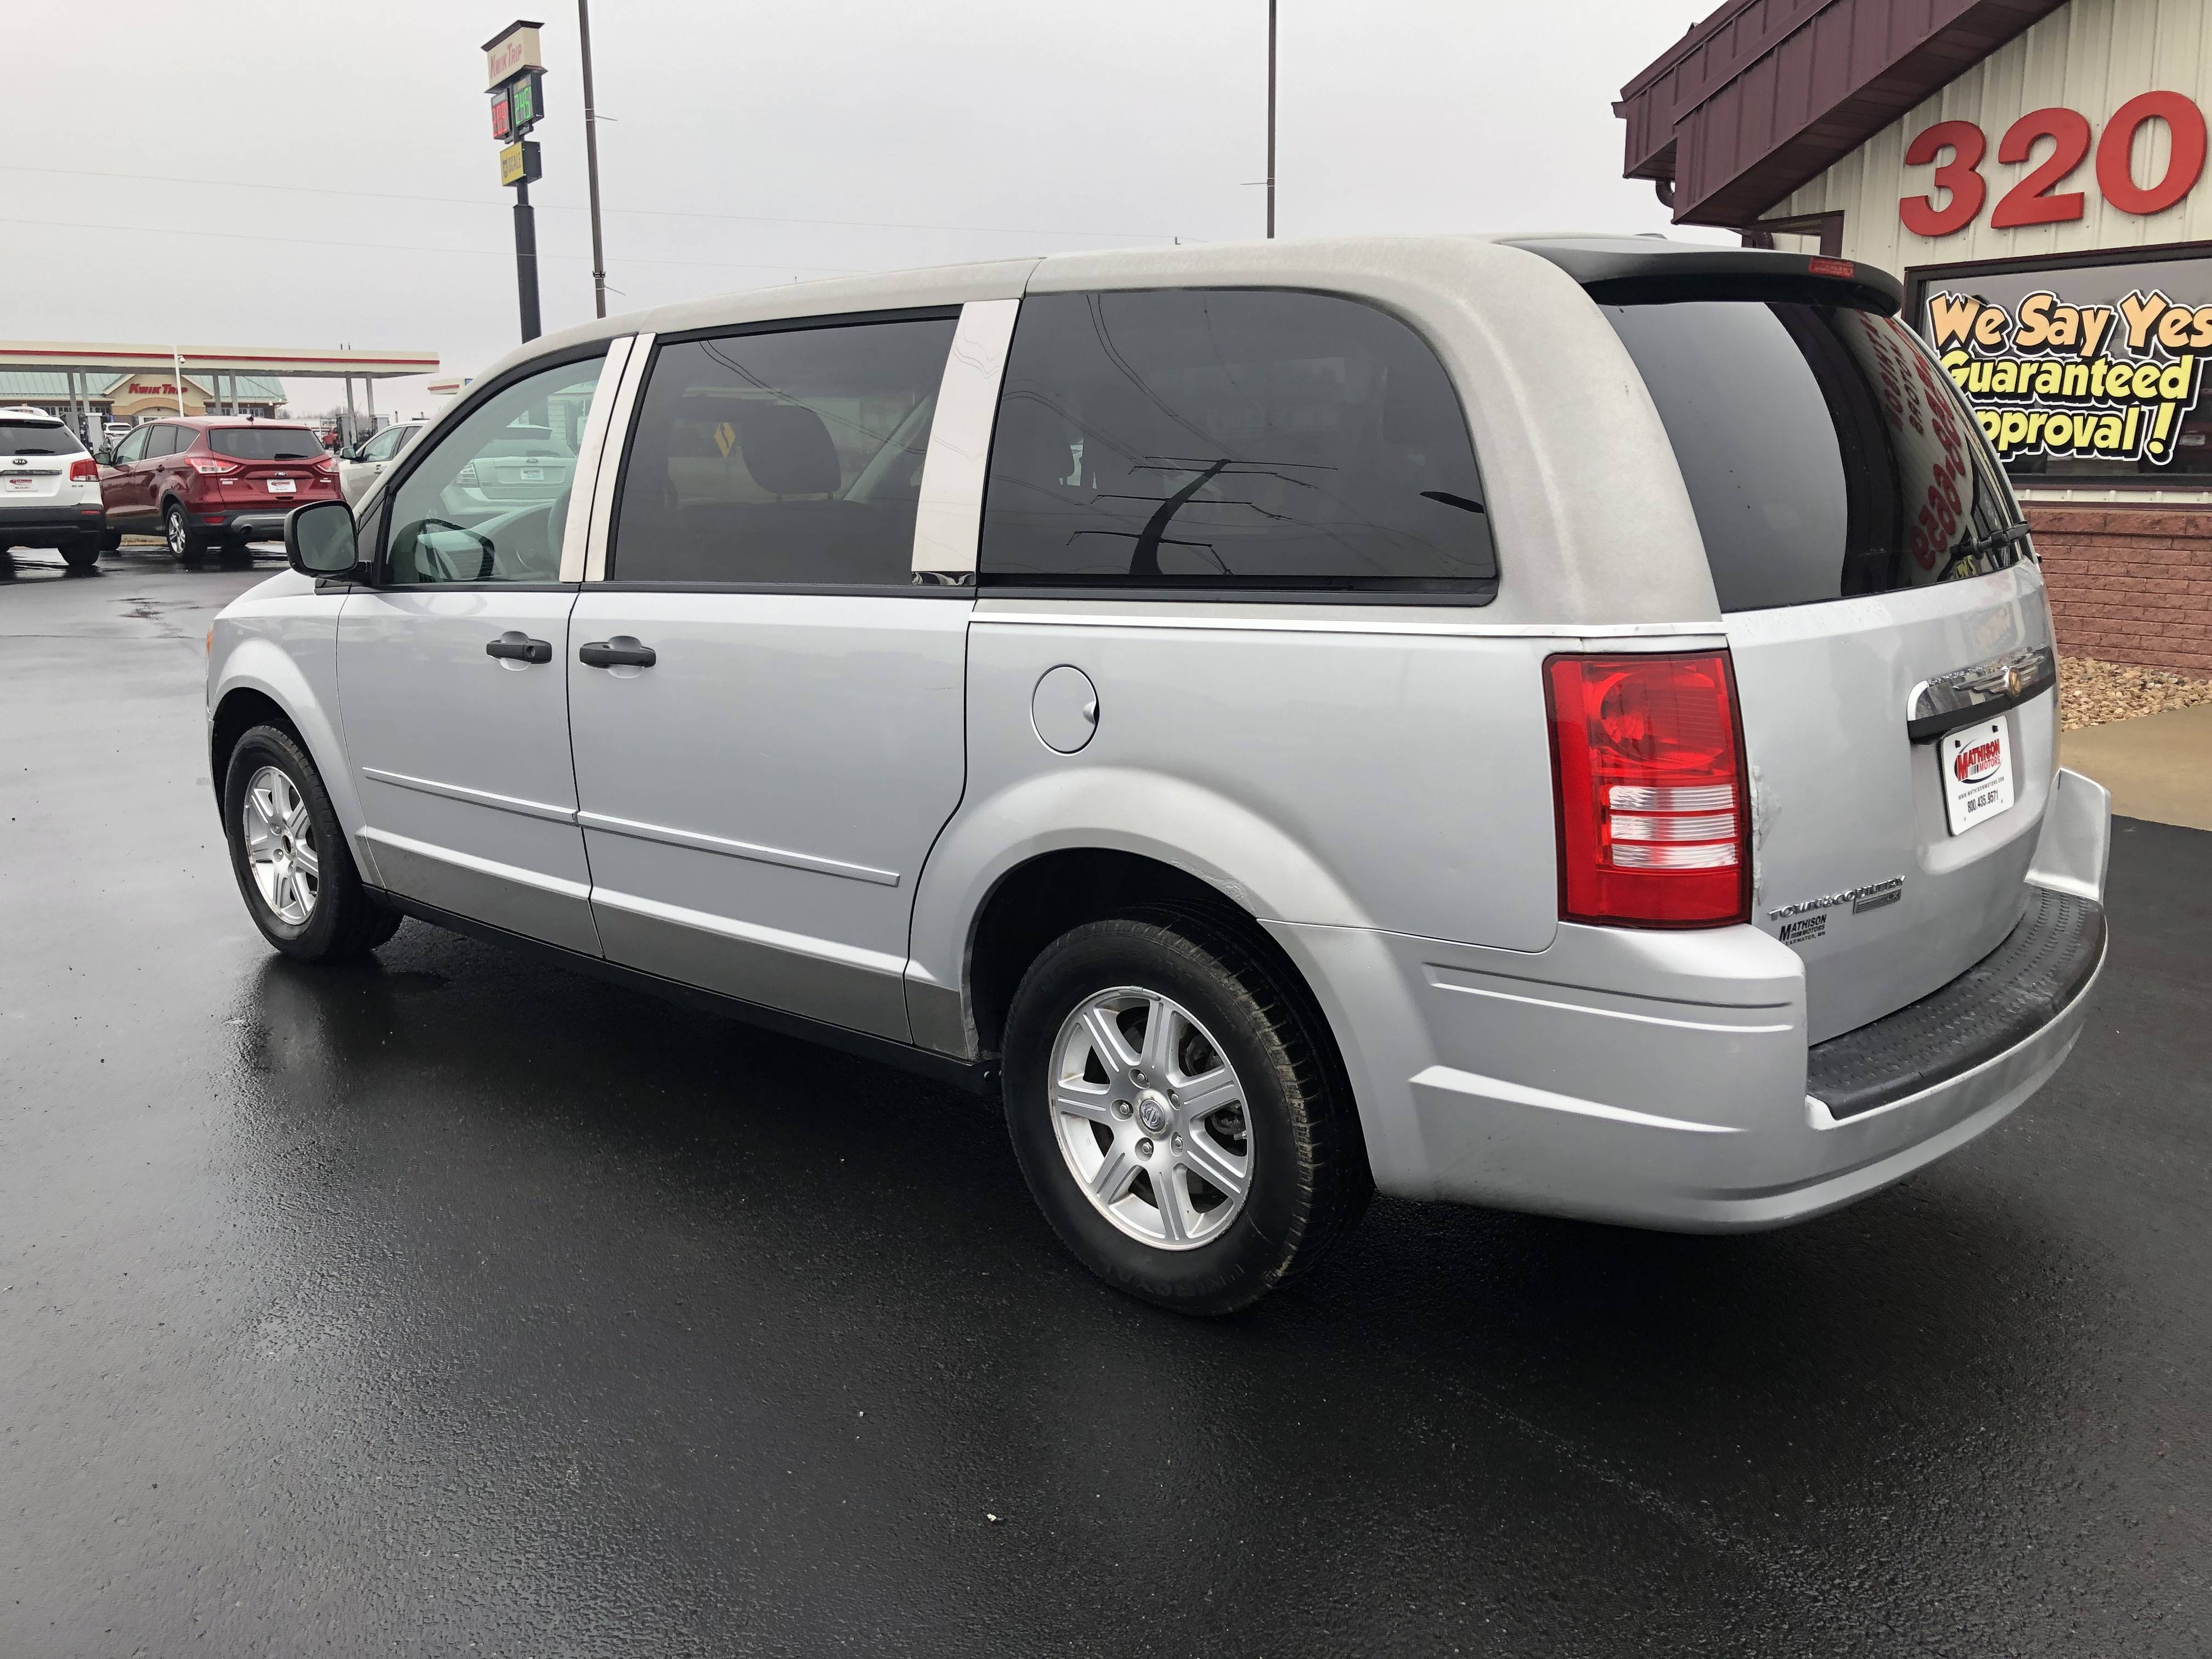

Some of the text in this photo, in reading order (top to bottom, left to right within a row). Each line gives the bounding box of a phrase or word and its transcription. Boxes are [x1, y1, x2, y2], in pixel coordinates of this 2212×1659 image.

[1899, 91, 2208, 237] 320
[1929, 291, 2212, 357] We Say Yes
[1939, 348, 2194, 399] Guaranteed
[1975, 402, 2176, 454] pproval!
[1957, 738, 2001, 781] MATHISON
[1979, 755, 2001, 772] MOTORS
[1967, 789, 1999, 813] 800.435.9571
[1779, 913, 1827, 941] MATHISON
[1785, 934, 1816, 946] EARWATER,
[1803, 924, 1825, 935] MOTORS
